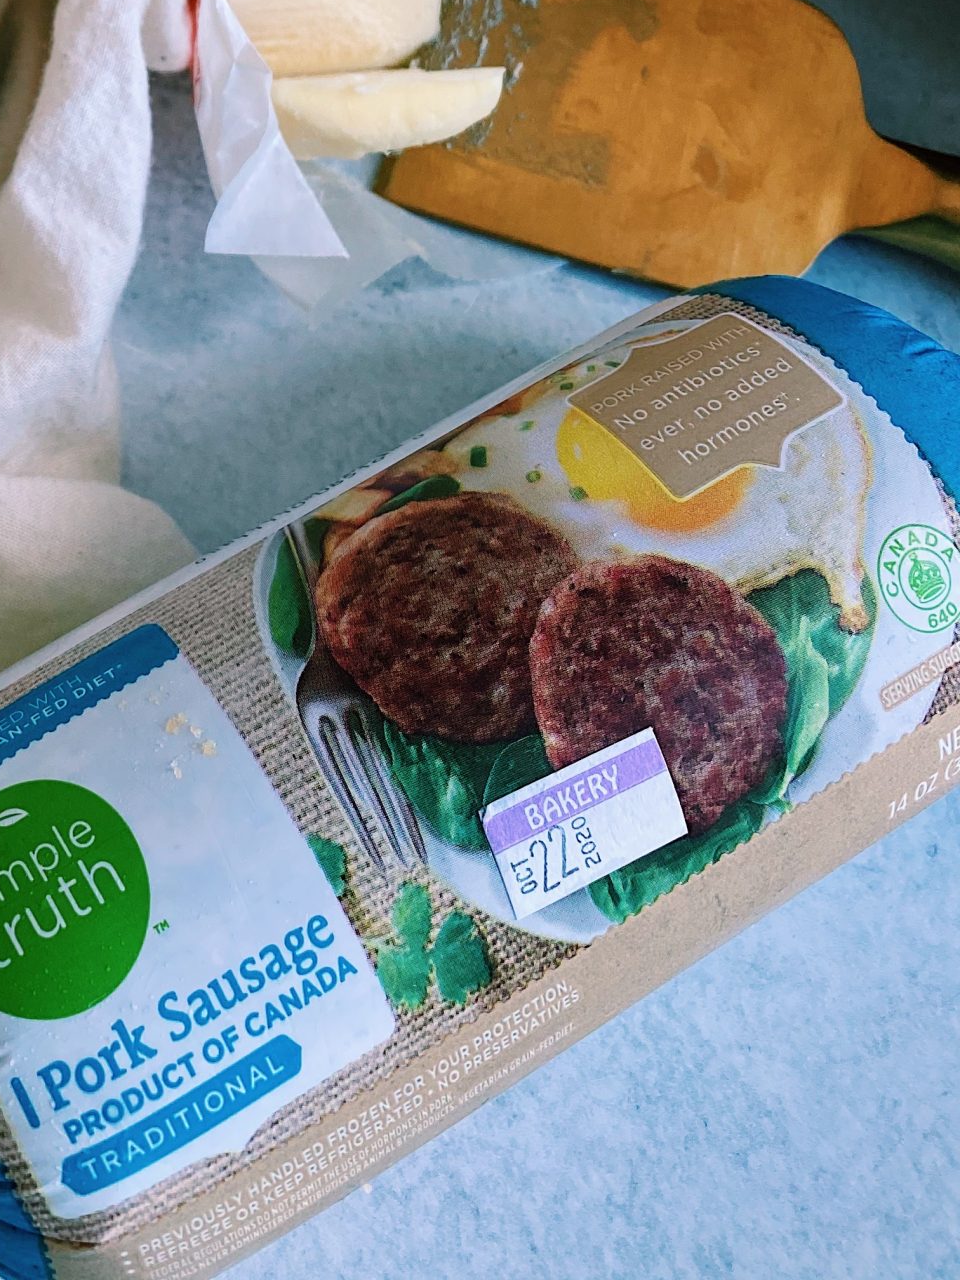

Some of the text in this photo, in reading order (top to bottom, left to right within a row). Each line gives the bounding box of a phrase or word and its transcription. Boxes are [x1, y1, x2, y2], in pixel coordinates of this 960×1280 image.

[590, 325, 752, 415] PORK RAISED WITH
[640, 357, 793, 451] ever, no added
[614, 408, 648, 430] No
[883, 530, 954, 597] CANADA
[928, 602, 957, 628] 640
[29, 674, 82, 711] WITH
[882, 665, 930, 706] SERVING
[524, 764, 619, 830] BAKERY
[889, 792, 908, 819] 14
[914, 771, 940, 801] OZ
[510, 816, 602, 895] OCT 22 2020
[37, 914, 335, 1112] Pork Sausage
[62, 955, 358, 1145] PRODUCT OF CANADA
[81, 1055, 285, 1180] TRADITIONAL
[139, 979, 573, 1257] PREVIOUSLY HANDLED FROZEN FOR YOUR PROTECTION,
[144, 989, 580, 1267] REFREEZE OR KEEP REFRIGERATED NO PRESERVATIVES
[193, 1222, 257, 1261] REGULATIONS
[256, 1211, 271, 1226] DO
[271, 1198, 291, 1215] NOT
[290, 1177, 323, 1204] PERMIT
[323, 1165, 343, 1180] THE
[341, 1154, 359, 1172] USE
[358, 1146, 371, 1160] OF
[371, 1113, 419, 1150] HORMONES
[418, 1104, 429, 1119] IN
[199, 1248, 228, 1269] NEVER
[230, 1207, 295, 1252] ADMINISTERED
[296, 1173, 349, 1213] ANTIBIOTICS
[350, 1164, 362, 1178] OR
[363, 1144, 396, 1169] ANIMAL
[458, 1067, 509, 1105] VEGETARIAN
